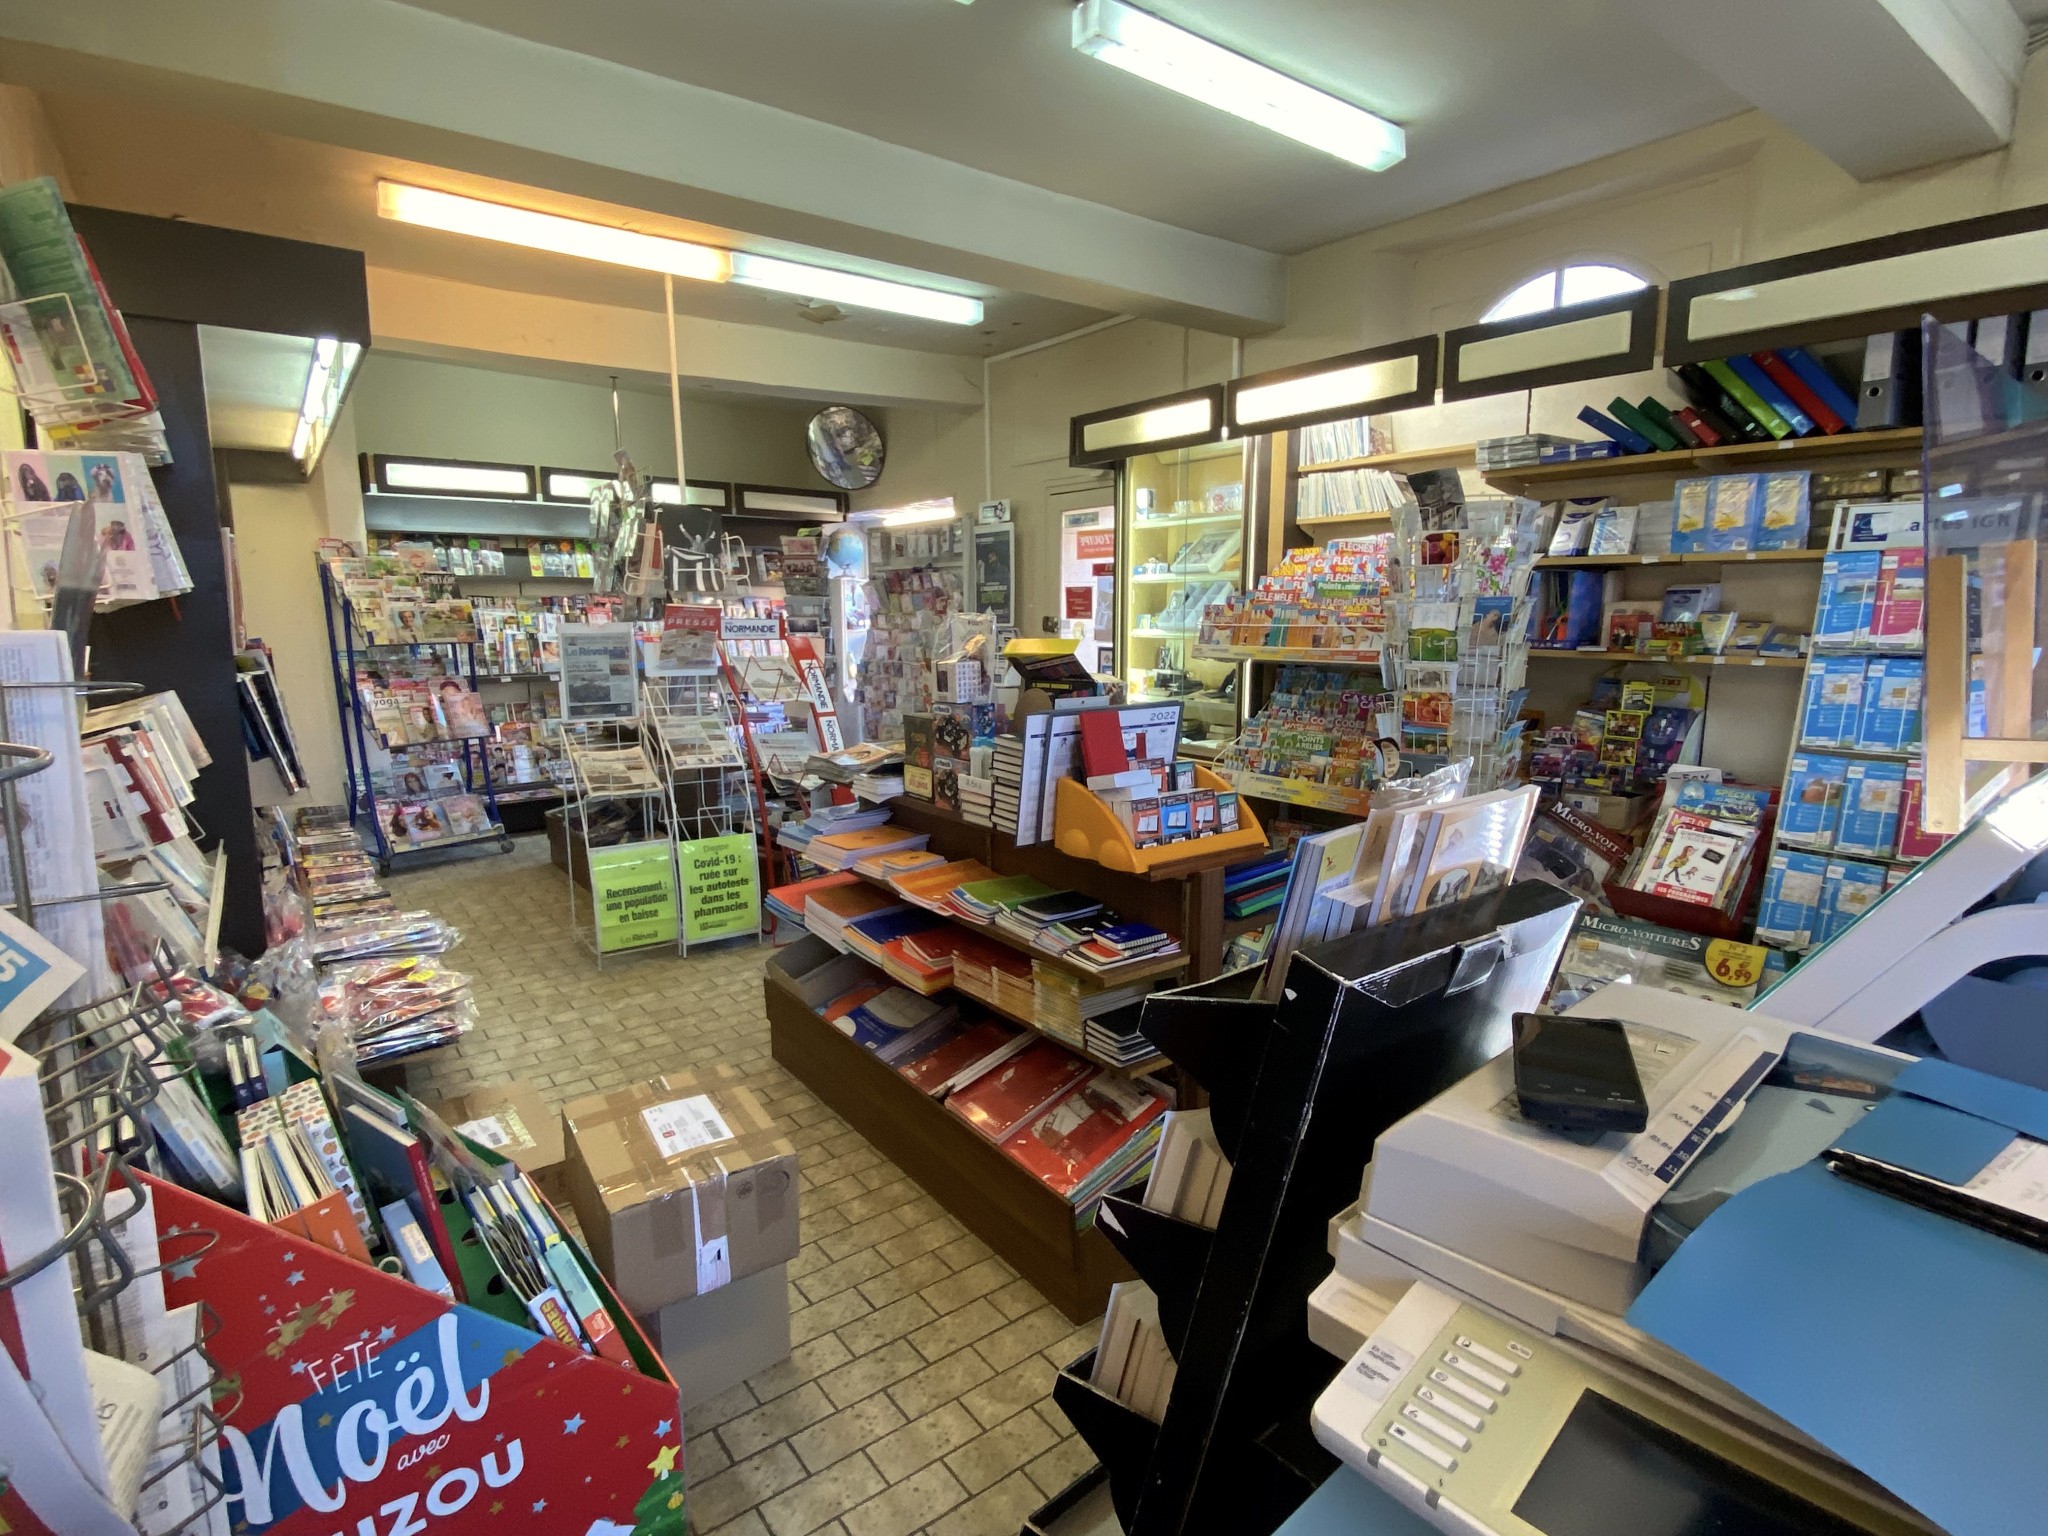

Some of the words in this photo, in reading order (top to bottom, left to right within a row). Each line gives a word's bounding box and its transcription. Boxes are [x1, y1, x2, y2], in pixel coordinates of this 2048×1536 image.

[667, 618, 716, 627] PRESSE
[724, 624, 776, 634] NORMANDIE
[805, 662, 828, 709] NORMANDIE
[373, 696, 399, 707] yoga
[1150, 711, 1176, 722] 2022
[1298, 735, 1324, 743] POINTS
[693, 854, 736, 870] Covid-19
[699, 868, 721, 881] ruée
[723, 866, 738, 877] sur
[606, 881, 663, 899] Recensement
[689, 885, 704, 895] les
[706, 877, 749, 892] autotests
[606, 900, 623, 911] une
[624, 893, 668, 909] population
[701, 894, 724, 905] dans
[727, 890, 741, 900] les
[619, 912, 630, 923] en
[631, 908, 659, 921] baisse
[694, 901, 749, 920] pharmacies
[306, 1339, 384, 1396] FÊTE
[397, 1433, 450, 1471] avec
